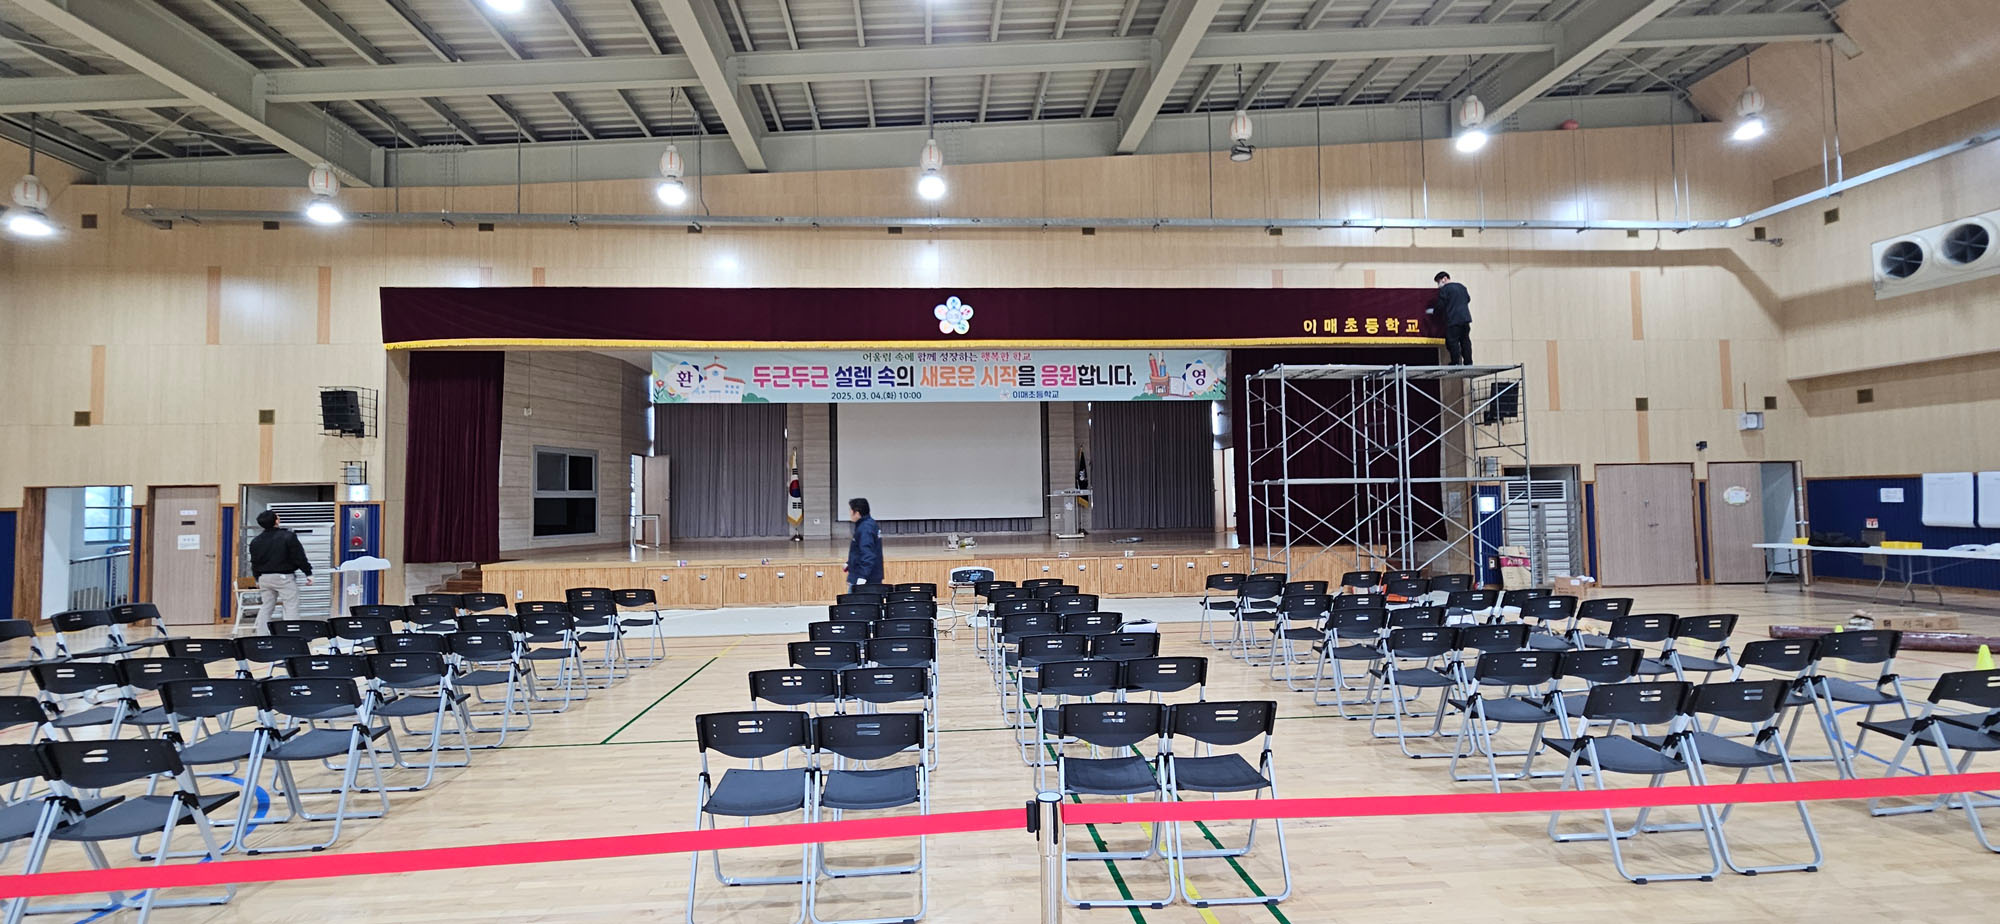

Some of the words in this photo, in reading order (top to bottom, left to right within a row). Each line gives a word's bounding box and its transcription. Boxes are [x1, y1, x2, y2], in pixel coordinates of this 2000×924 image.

[1303, 317, 1420, 335] 이매초등학교
[862, 352, 892, 362] 어울림
[895, 352, 915, 362] 속에
[917, 352, 937, 362] 함께
[940, 352, 978, 362] 성장하는
[981, 352, 1009, 362] 행복한
[1013, 352, 1032, 362] 학교
[676, 370, 693, 388] 환
[753, 366, 829, 388] 두근두근
[835, 365, 872, 388] 설렘
[877, 365, 915, 388] 속의
[920, 365, 976, 388] 새로운
[980, 365, 1036, 387] 시작을
[1041, 364, 1137, 387] 응원합니다.
[1192, 369, 1207, 386] 영
[831, 392, 854, 400] 2025.
[855, 392, 869, 400] 03.
[870, 391, 897, 400] 04.(화)
[899, 392, 922, 400] 10:00
[1012, 390, 1059, 399] 이매초등학교
